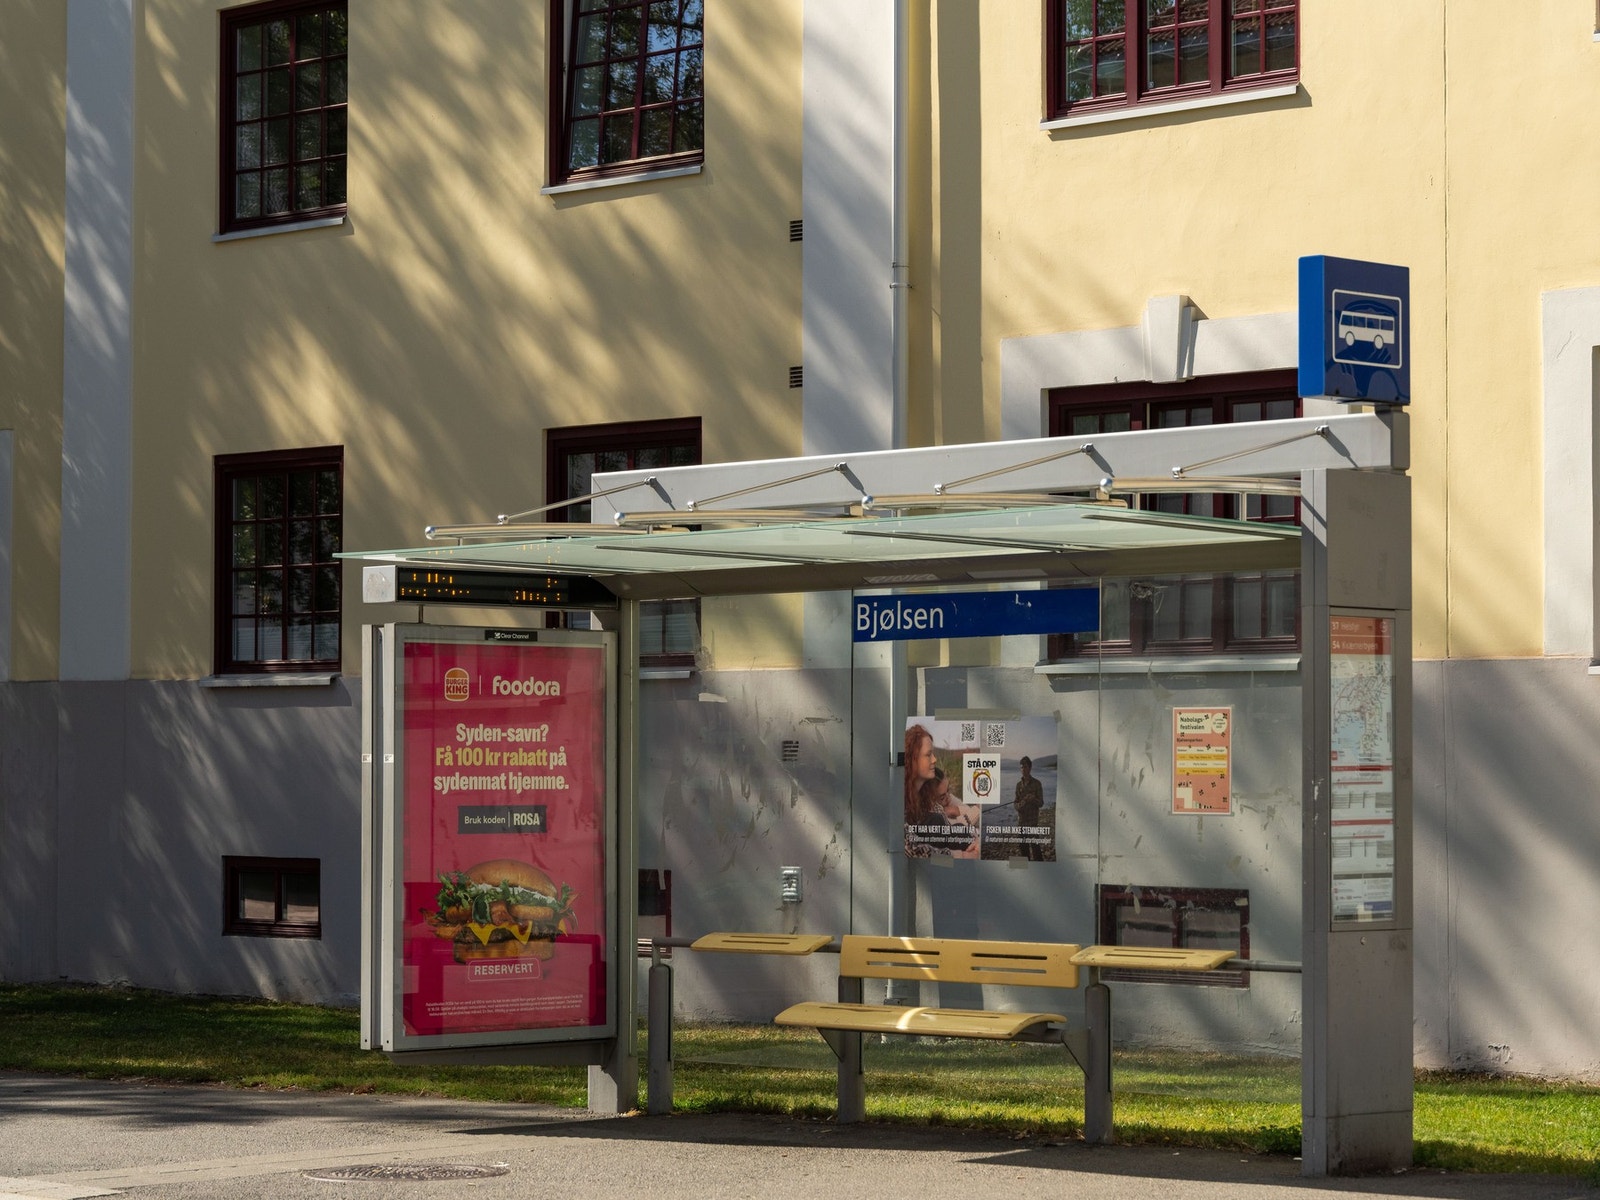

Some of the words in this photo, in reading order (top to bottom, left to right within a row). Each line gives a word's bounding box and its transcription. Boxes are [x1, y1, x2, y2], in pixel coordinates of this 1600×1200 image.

[857, 601, 943, 638] Bjølsen
[1332, 622, 1339, 630] 37
[1332, 641, 1340, 649] 54
[446, 686, 468, 694] KING
[492, 676, 560, 696] foodora
[456, 723, 549, 746] Syden-savn?
[436, 746, 453, 766] Få
[456, 748, 483, 766] 100
[486, 747, 500, 765] kr
[503, 747, 547, 765] rabatt
[549, 746, 566, 770] på
[968, 758, 981, 768] STÅ
[982, 760, 996, 768] OPP
[434, 772, 506, 795] sydenmat
[509, 772, 569, 794] hjemme.
[464, 816, 481, 824] Bruk
[483, 815, 505, 824] koden
[513, 812, 540, 826] ROSA
[908, 825, 917, 833] DET
[918, 825, 927, 833] HAR
[1002, 826, 1011, 834] HAR
[474, 963, 533, 976] RESERVERT
